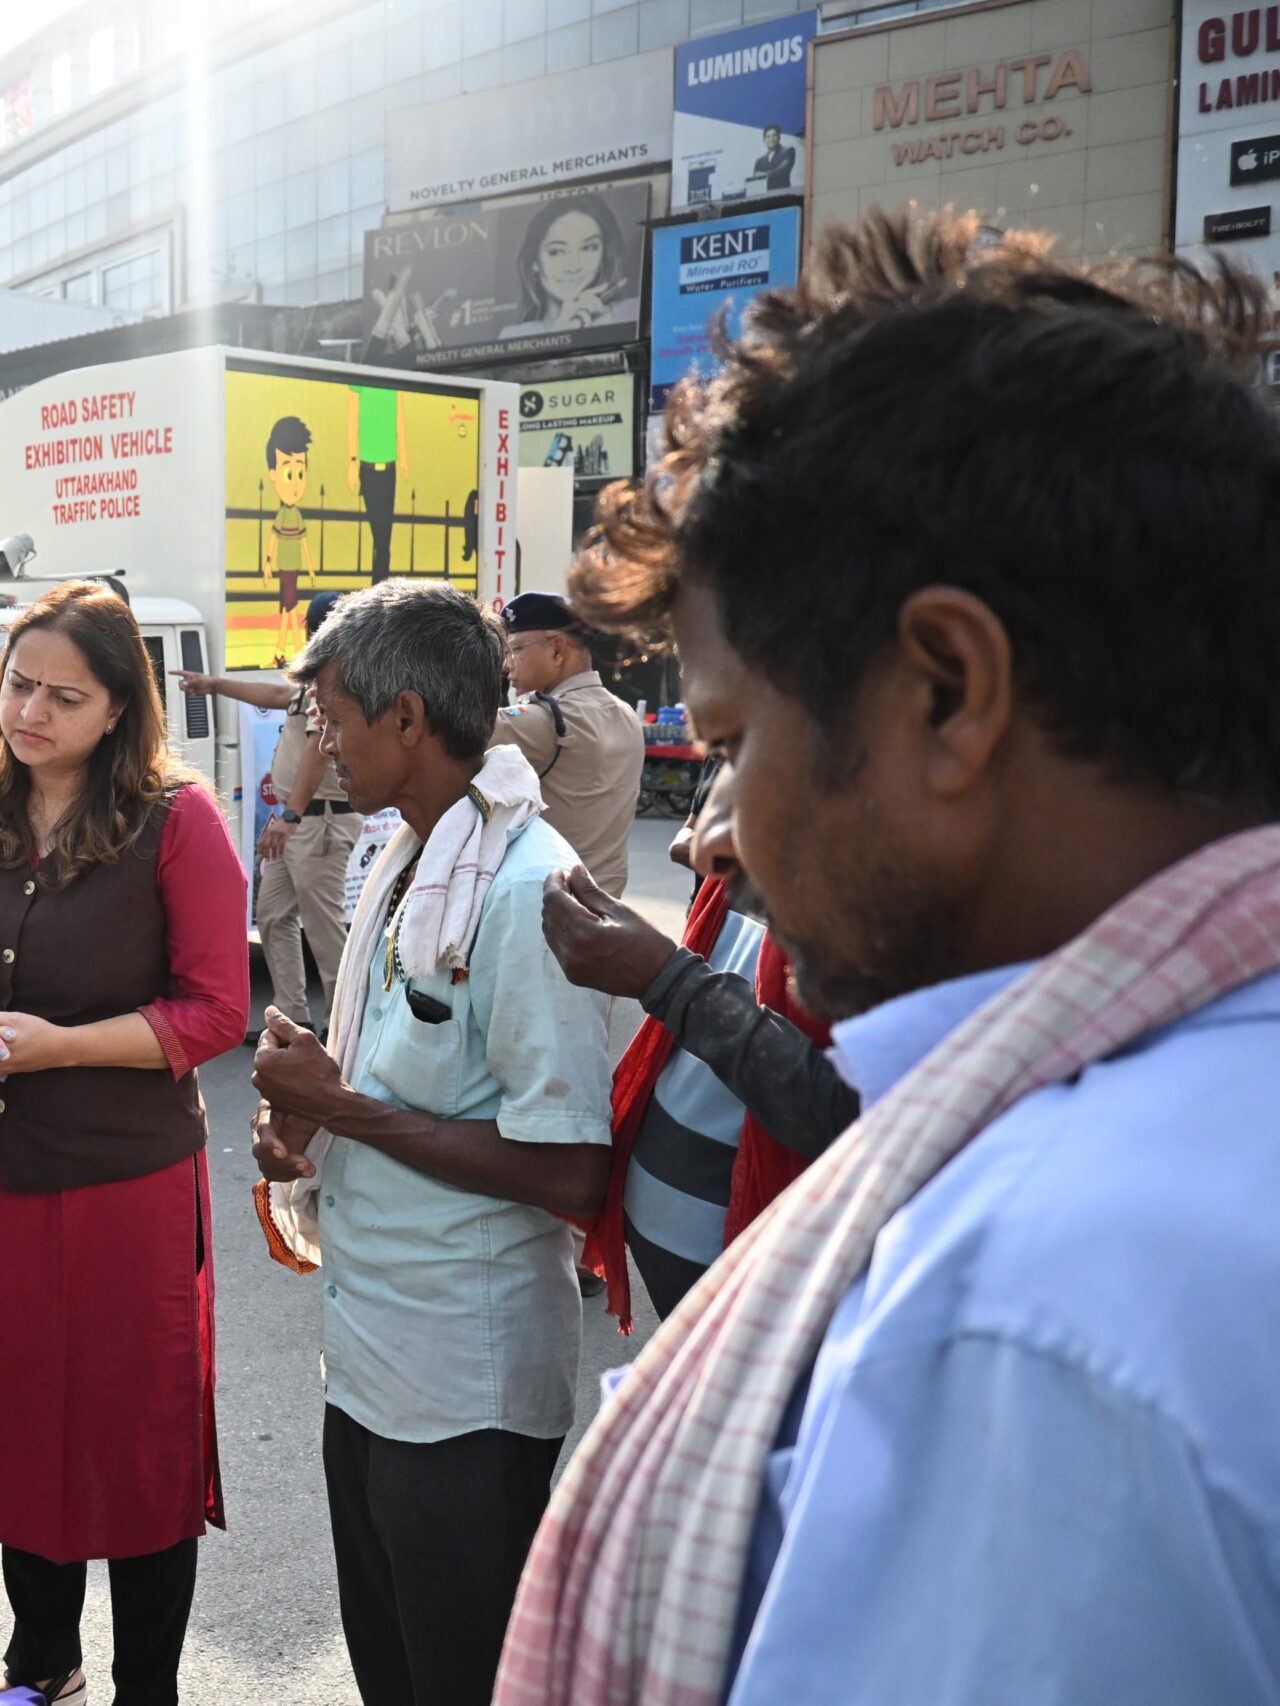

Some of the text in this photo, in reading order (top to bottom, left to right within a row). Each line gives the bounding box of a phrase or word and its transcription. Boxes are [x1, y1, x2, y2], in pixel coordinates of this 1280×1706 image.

[688, 35, 803, 87] LUMINOUS
[873, 49, 1093, 131] MEHTA
[891, 116, 1072, 167] WATCH CO.
[410, 143, 648, 201] NOVELTY GENERAL MERCHANTS
[374, 221, 490, 259] REVLON
[691, 228, 758, 261] KENT
[686, 262, 735, 279] Mineral
[686, 276, 762, 293] Water Purifiers
[416, 334, 571, 365] NOVELTY GENERAL MERCHANTS
[41, 391, 136, 431] ROAD SAFETY
[549, 390, 616, 409] SUGAR
[542, 418, 578, 430] LASTING
[580, 415, 616, 427] MAKEUP
[25, 427, 173, 470] EXHIBITION VEHICLE
[55, 469, 138, 499] UTTARAKHAND
[53, 495, 140, 525] TRAFFIC POLICE
